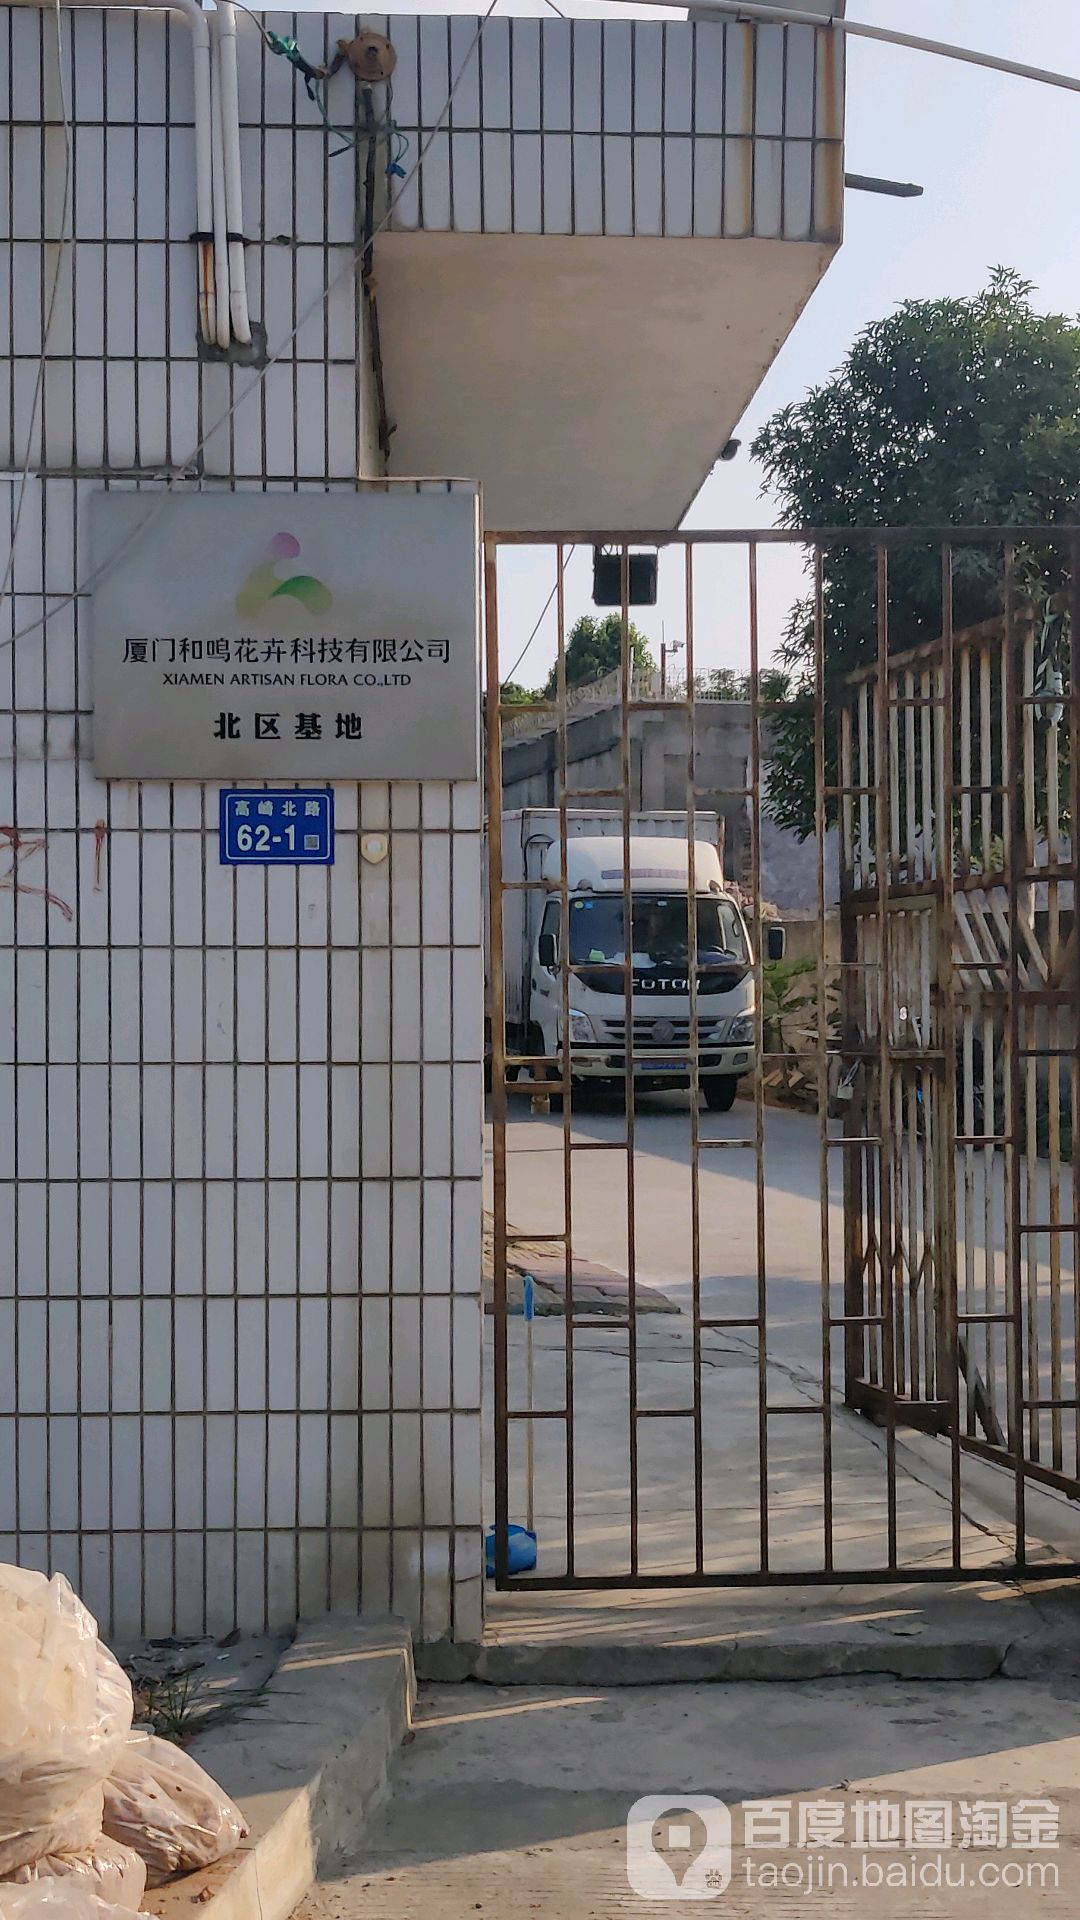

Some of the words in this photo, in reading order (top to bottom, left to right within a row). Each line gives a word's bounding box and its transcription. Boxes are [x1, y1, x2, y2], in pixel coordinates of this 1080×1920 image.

[122, 637, 450, 664] 厦门和鸣花卉科技有限公司
[162, 673, 225, 685] XIAMEN
[230, 673, 295, 686] ARTISAN
[300, 673, 349, 686] FLORA
[213, 712, 362, 740] 北区基地
[235, 800, 320, 816] 高崎北路
[237, 824, 295, 851] 62-1
